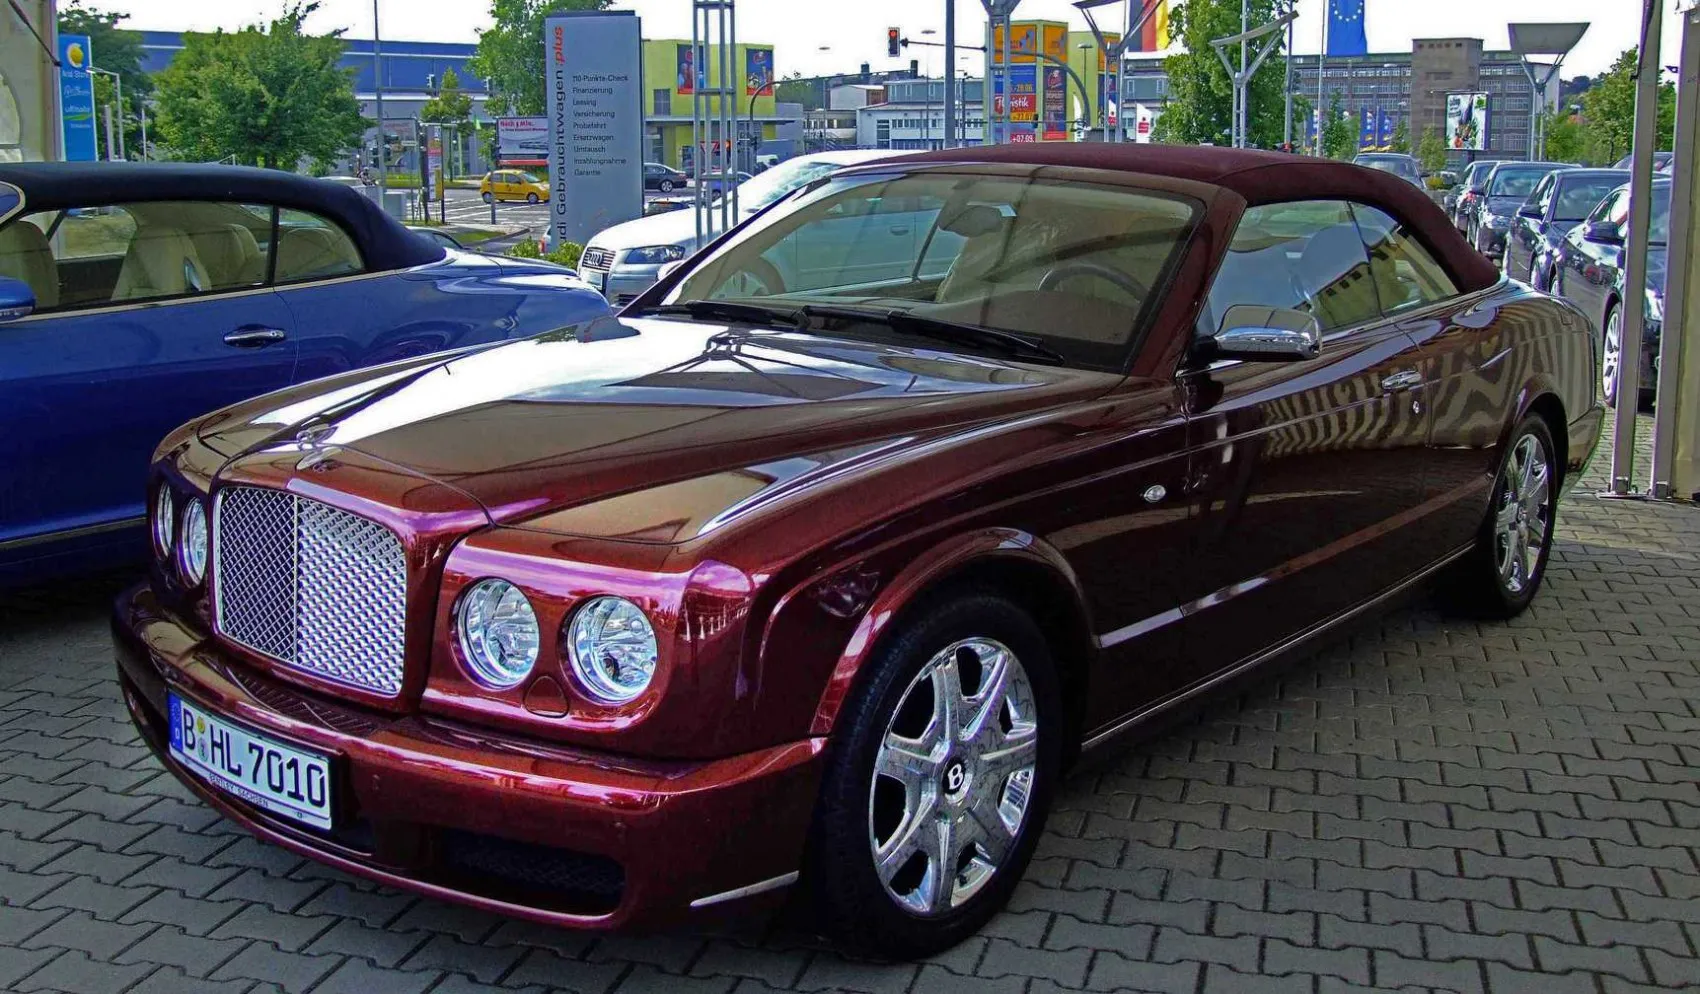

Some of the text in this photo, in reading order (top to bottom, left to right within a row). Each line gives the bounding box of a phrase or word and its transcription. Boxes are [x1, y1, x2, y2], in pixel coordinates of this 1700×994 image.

[572, 87, 614, 95] Finanzierung
[572, 99, 597, 107] Leasing
[573, 111, 616, 119] Versicherung
[573, 122, 607, 130] Probefahrt
[573, 134, 615, 142] Ersatzwagen
[556, 70, 567, 215] Gebrauchtwagen
[573, 146, 606, 154] Umtausch
[183, 708, 325, 808] B HL 7010
